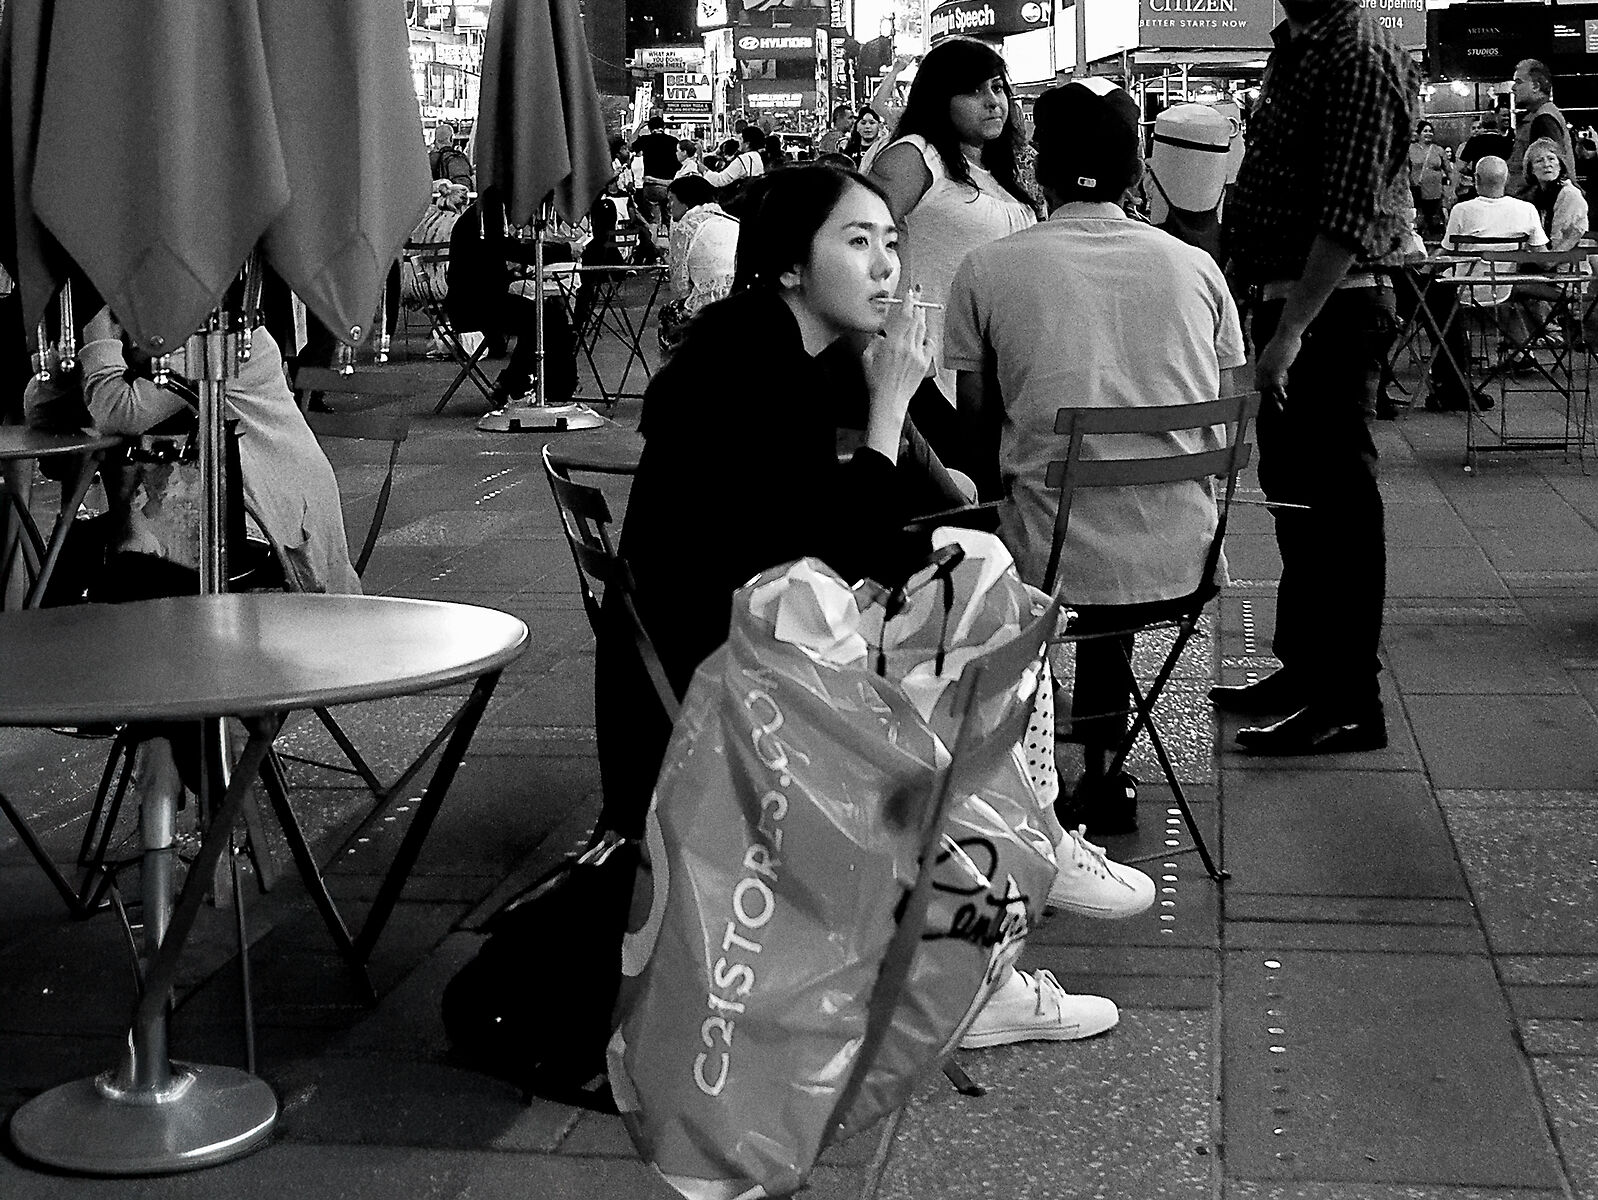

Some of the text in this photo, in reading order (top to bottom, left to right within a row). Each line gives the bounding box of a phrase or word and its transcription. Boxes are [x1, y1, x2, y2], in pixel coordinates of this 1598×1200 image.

[955, 4, 995, 33] Speech
[1139, 20, 1247, 28] BETTER STARTS NOW
[1467, 48, 1499, 56] STUDIOS
[666, 74, 710, 87] BELLA
[666, 87, 698, 99] VITA
